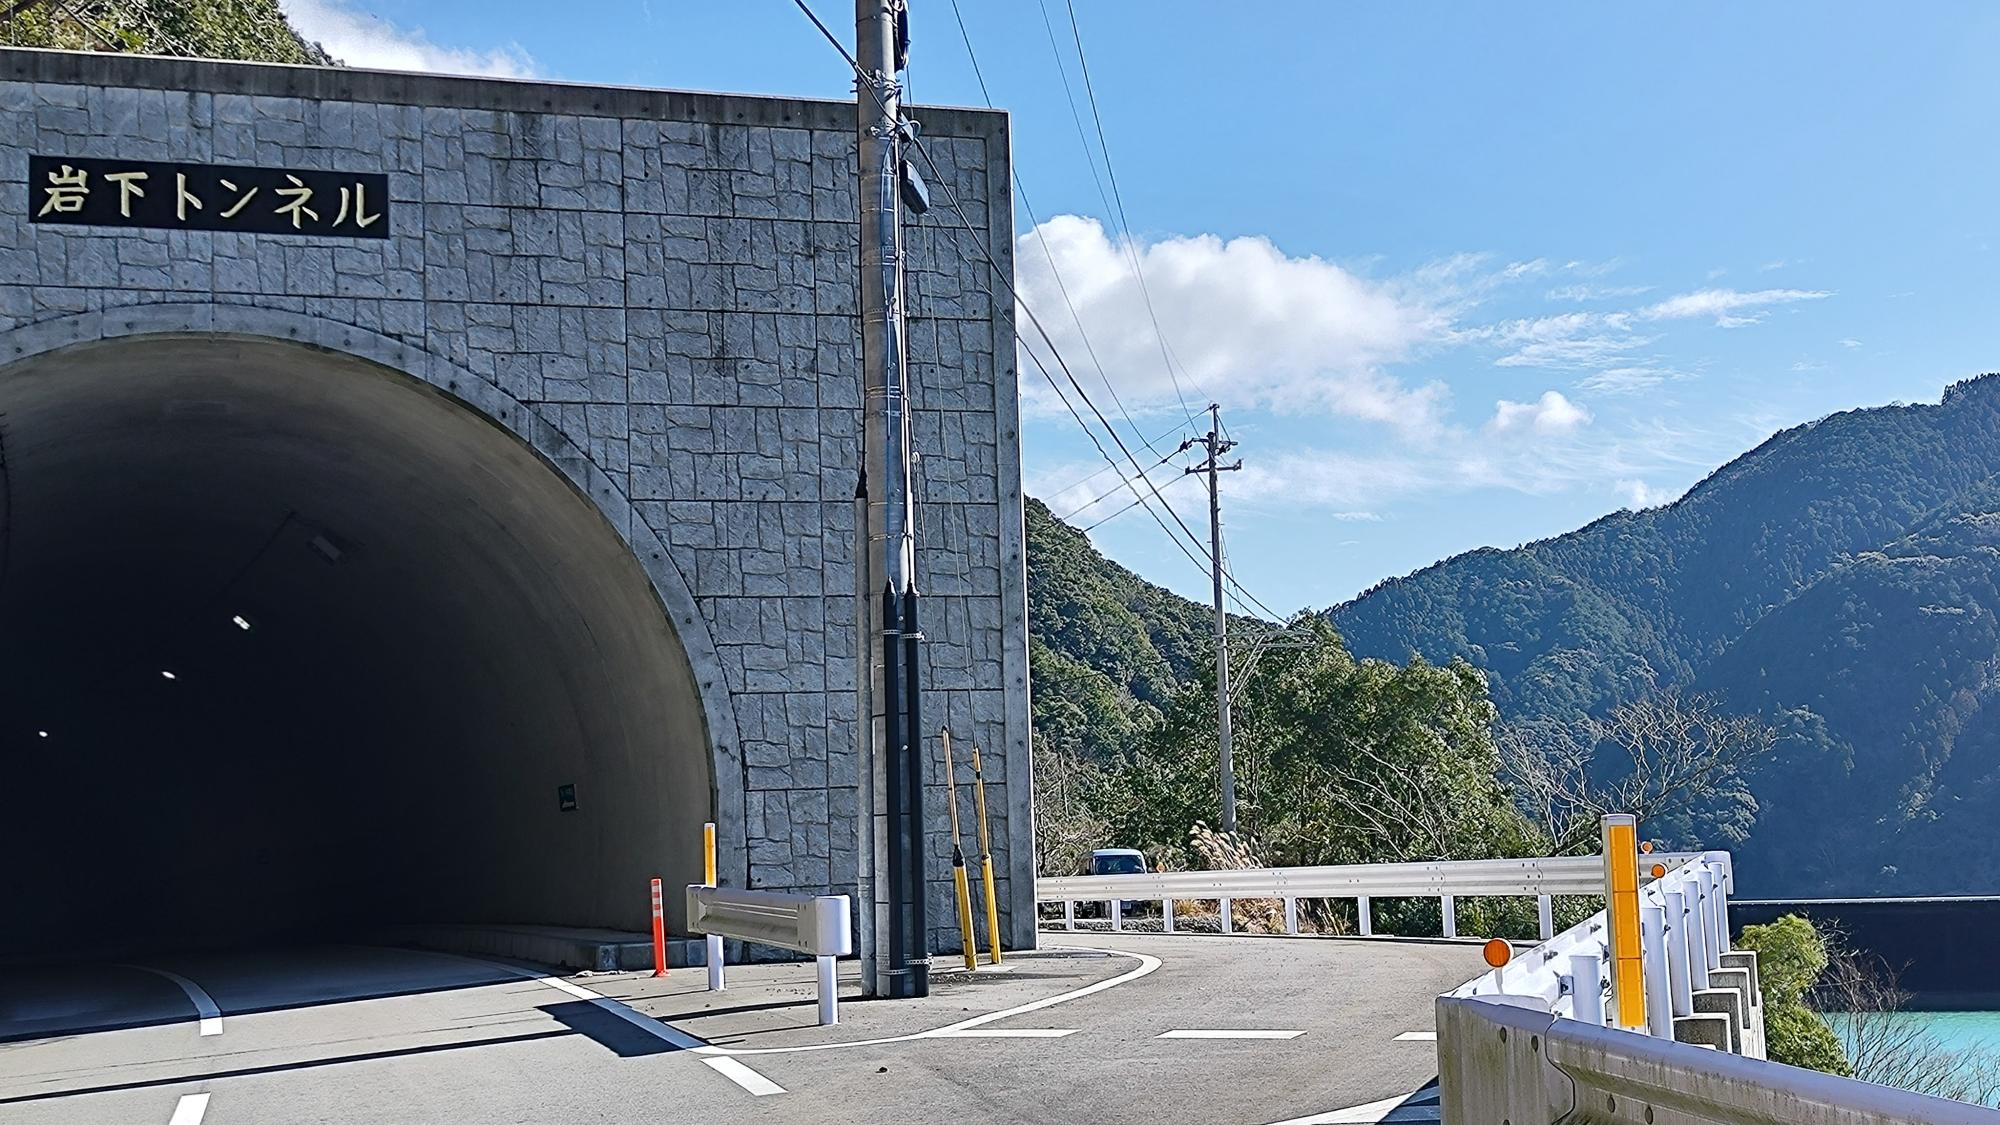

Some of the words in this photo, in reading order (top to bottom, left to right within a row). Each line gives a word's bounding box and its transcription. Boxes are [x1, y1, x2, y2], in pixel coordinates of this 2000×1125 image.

[38, 165, 381, 229] 岩下トンネル
